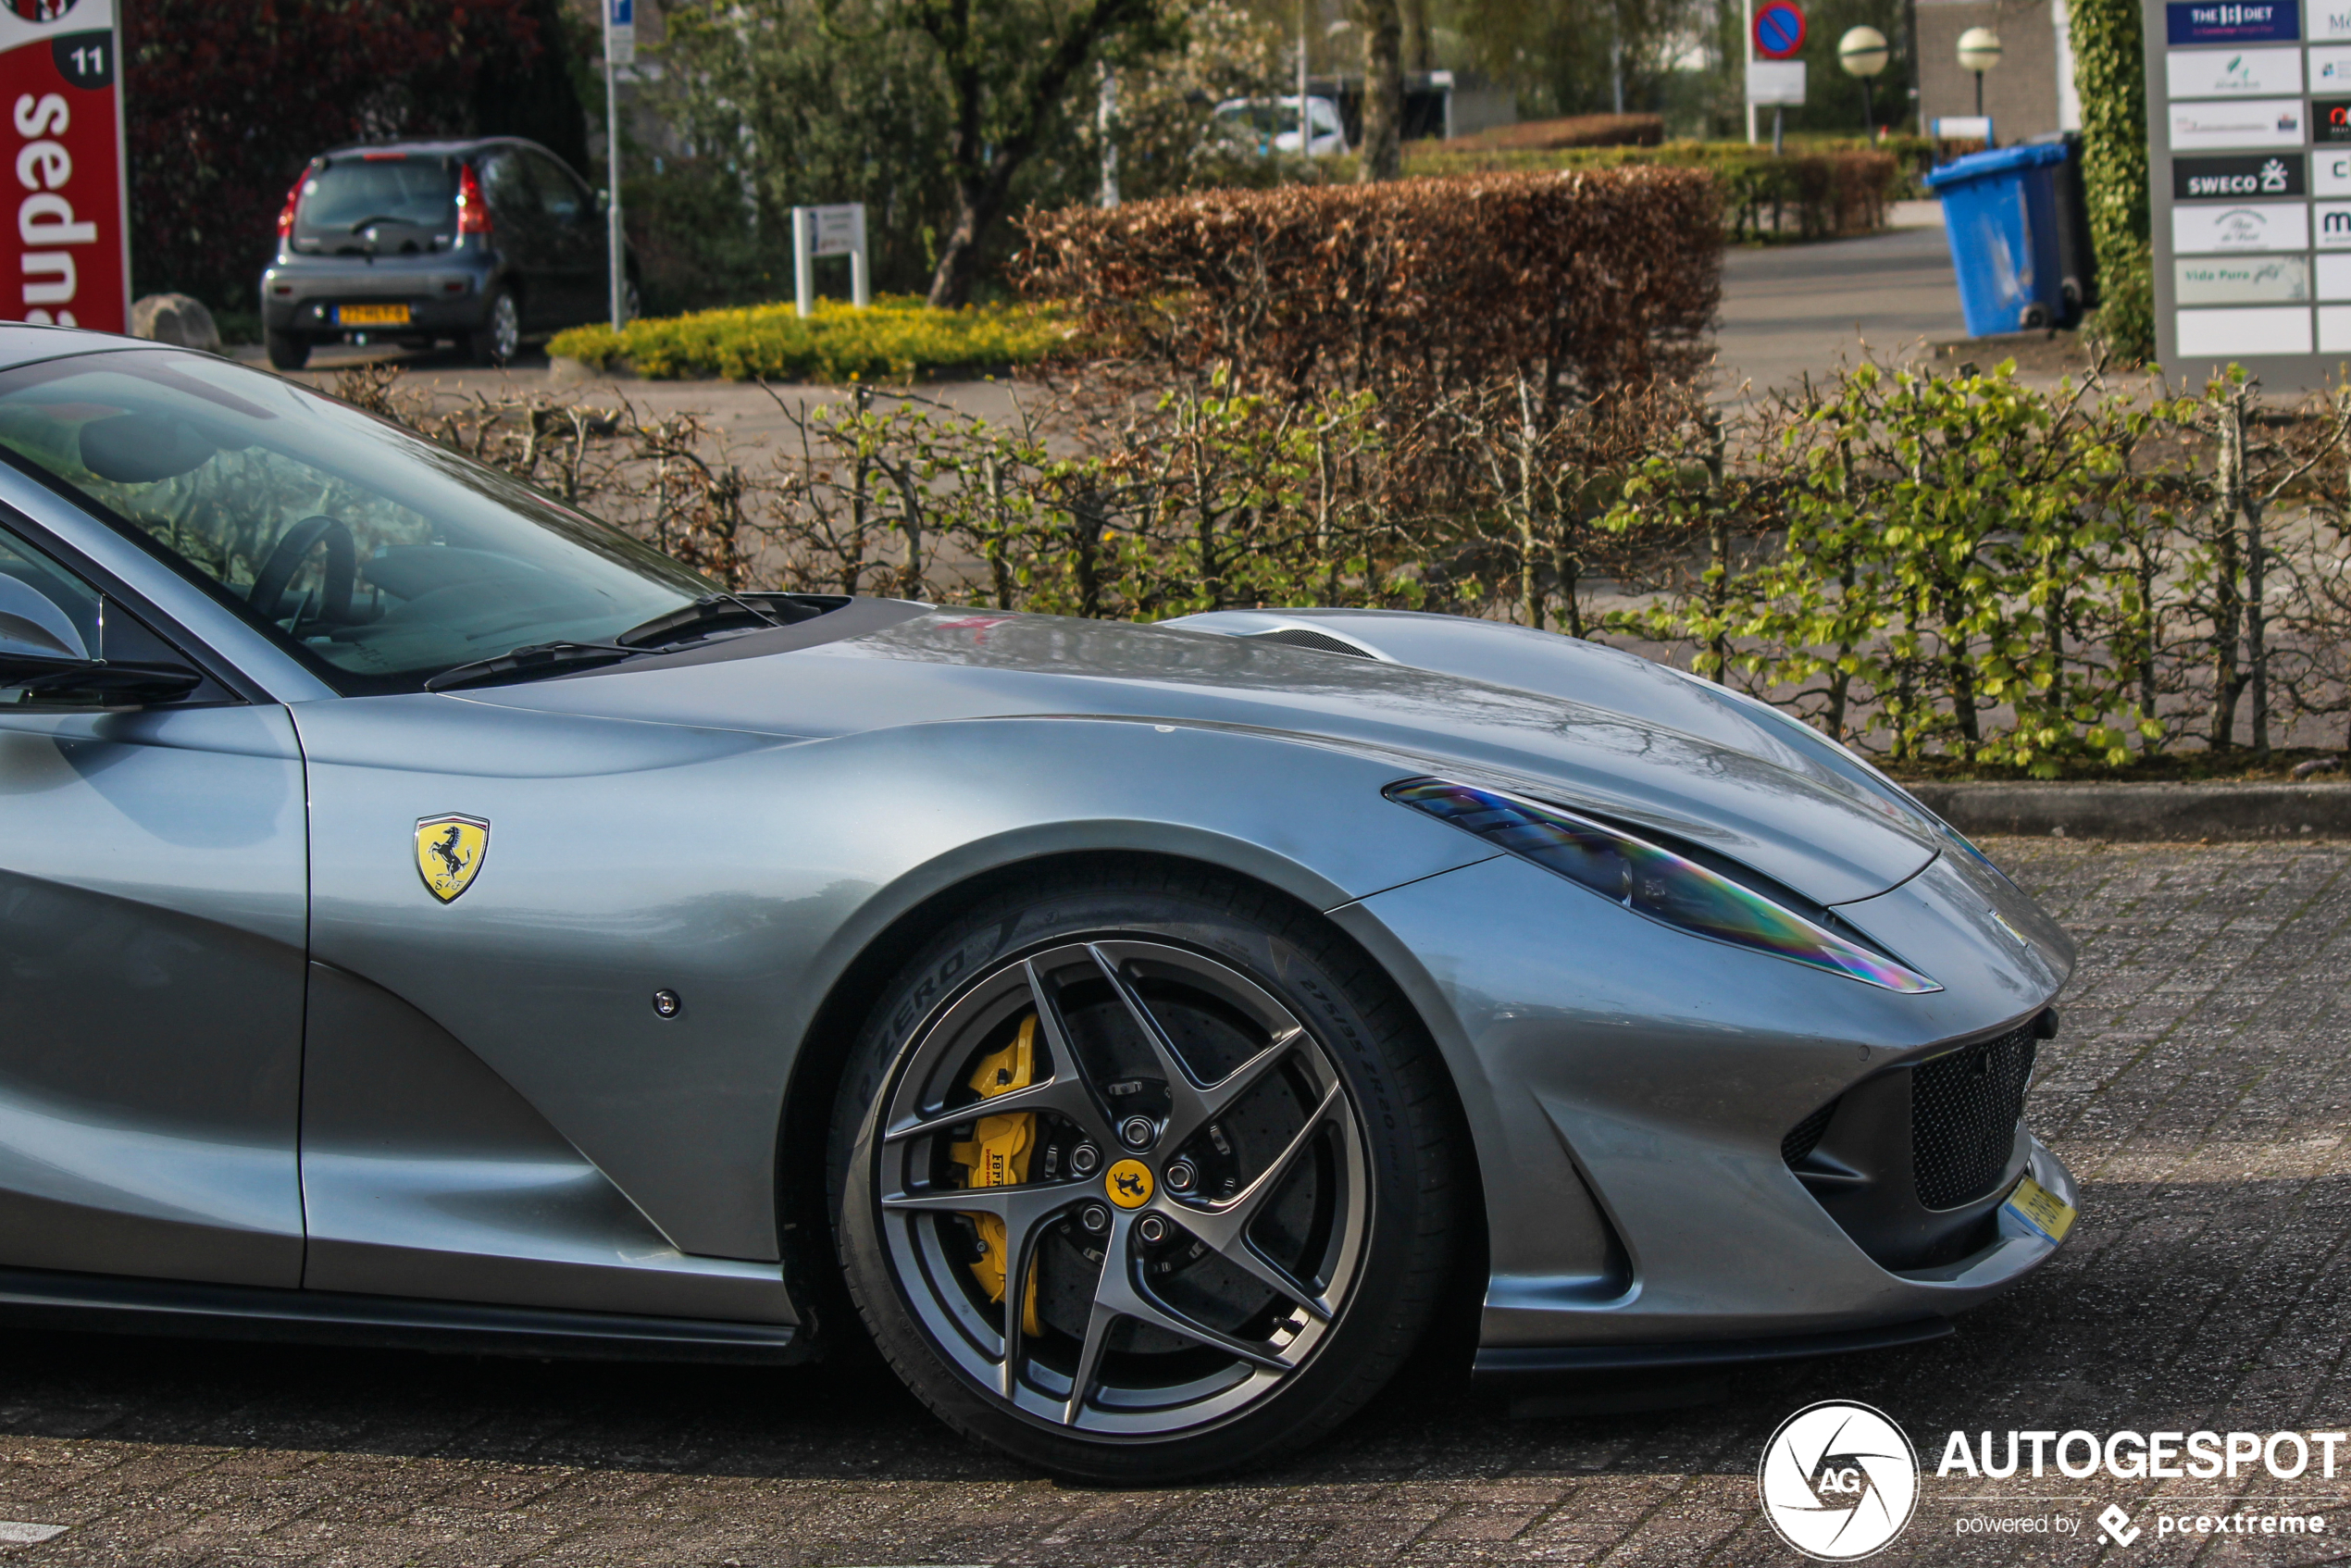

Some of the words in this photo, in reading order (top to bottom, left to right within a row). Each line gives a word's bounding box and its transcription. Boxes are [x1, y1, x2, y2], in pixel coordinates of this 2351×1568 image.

[2192, 8, 2218, 23] THE
[2244, 6, 2273, 21] DIET
[71, 46, 103, 75] 11
[2189, 176, 2258, 195] SWECO
[2185, 269, 2215, 280] Vida
[875, 948, 965, 1070] ZERO
[1300, 977, 1366, 1053] 275/35
